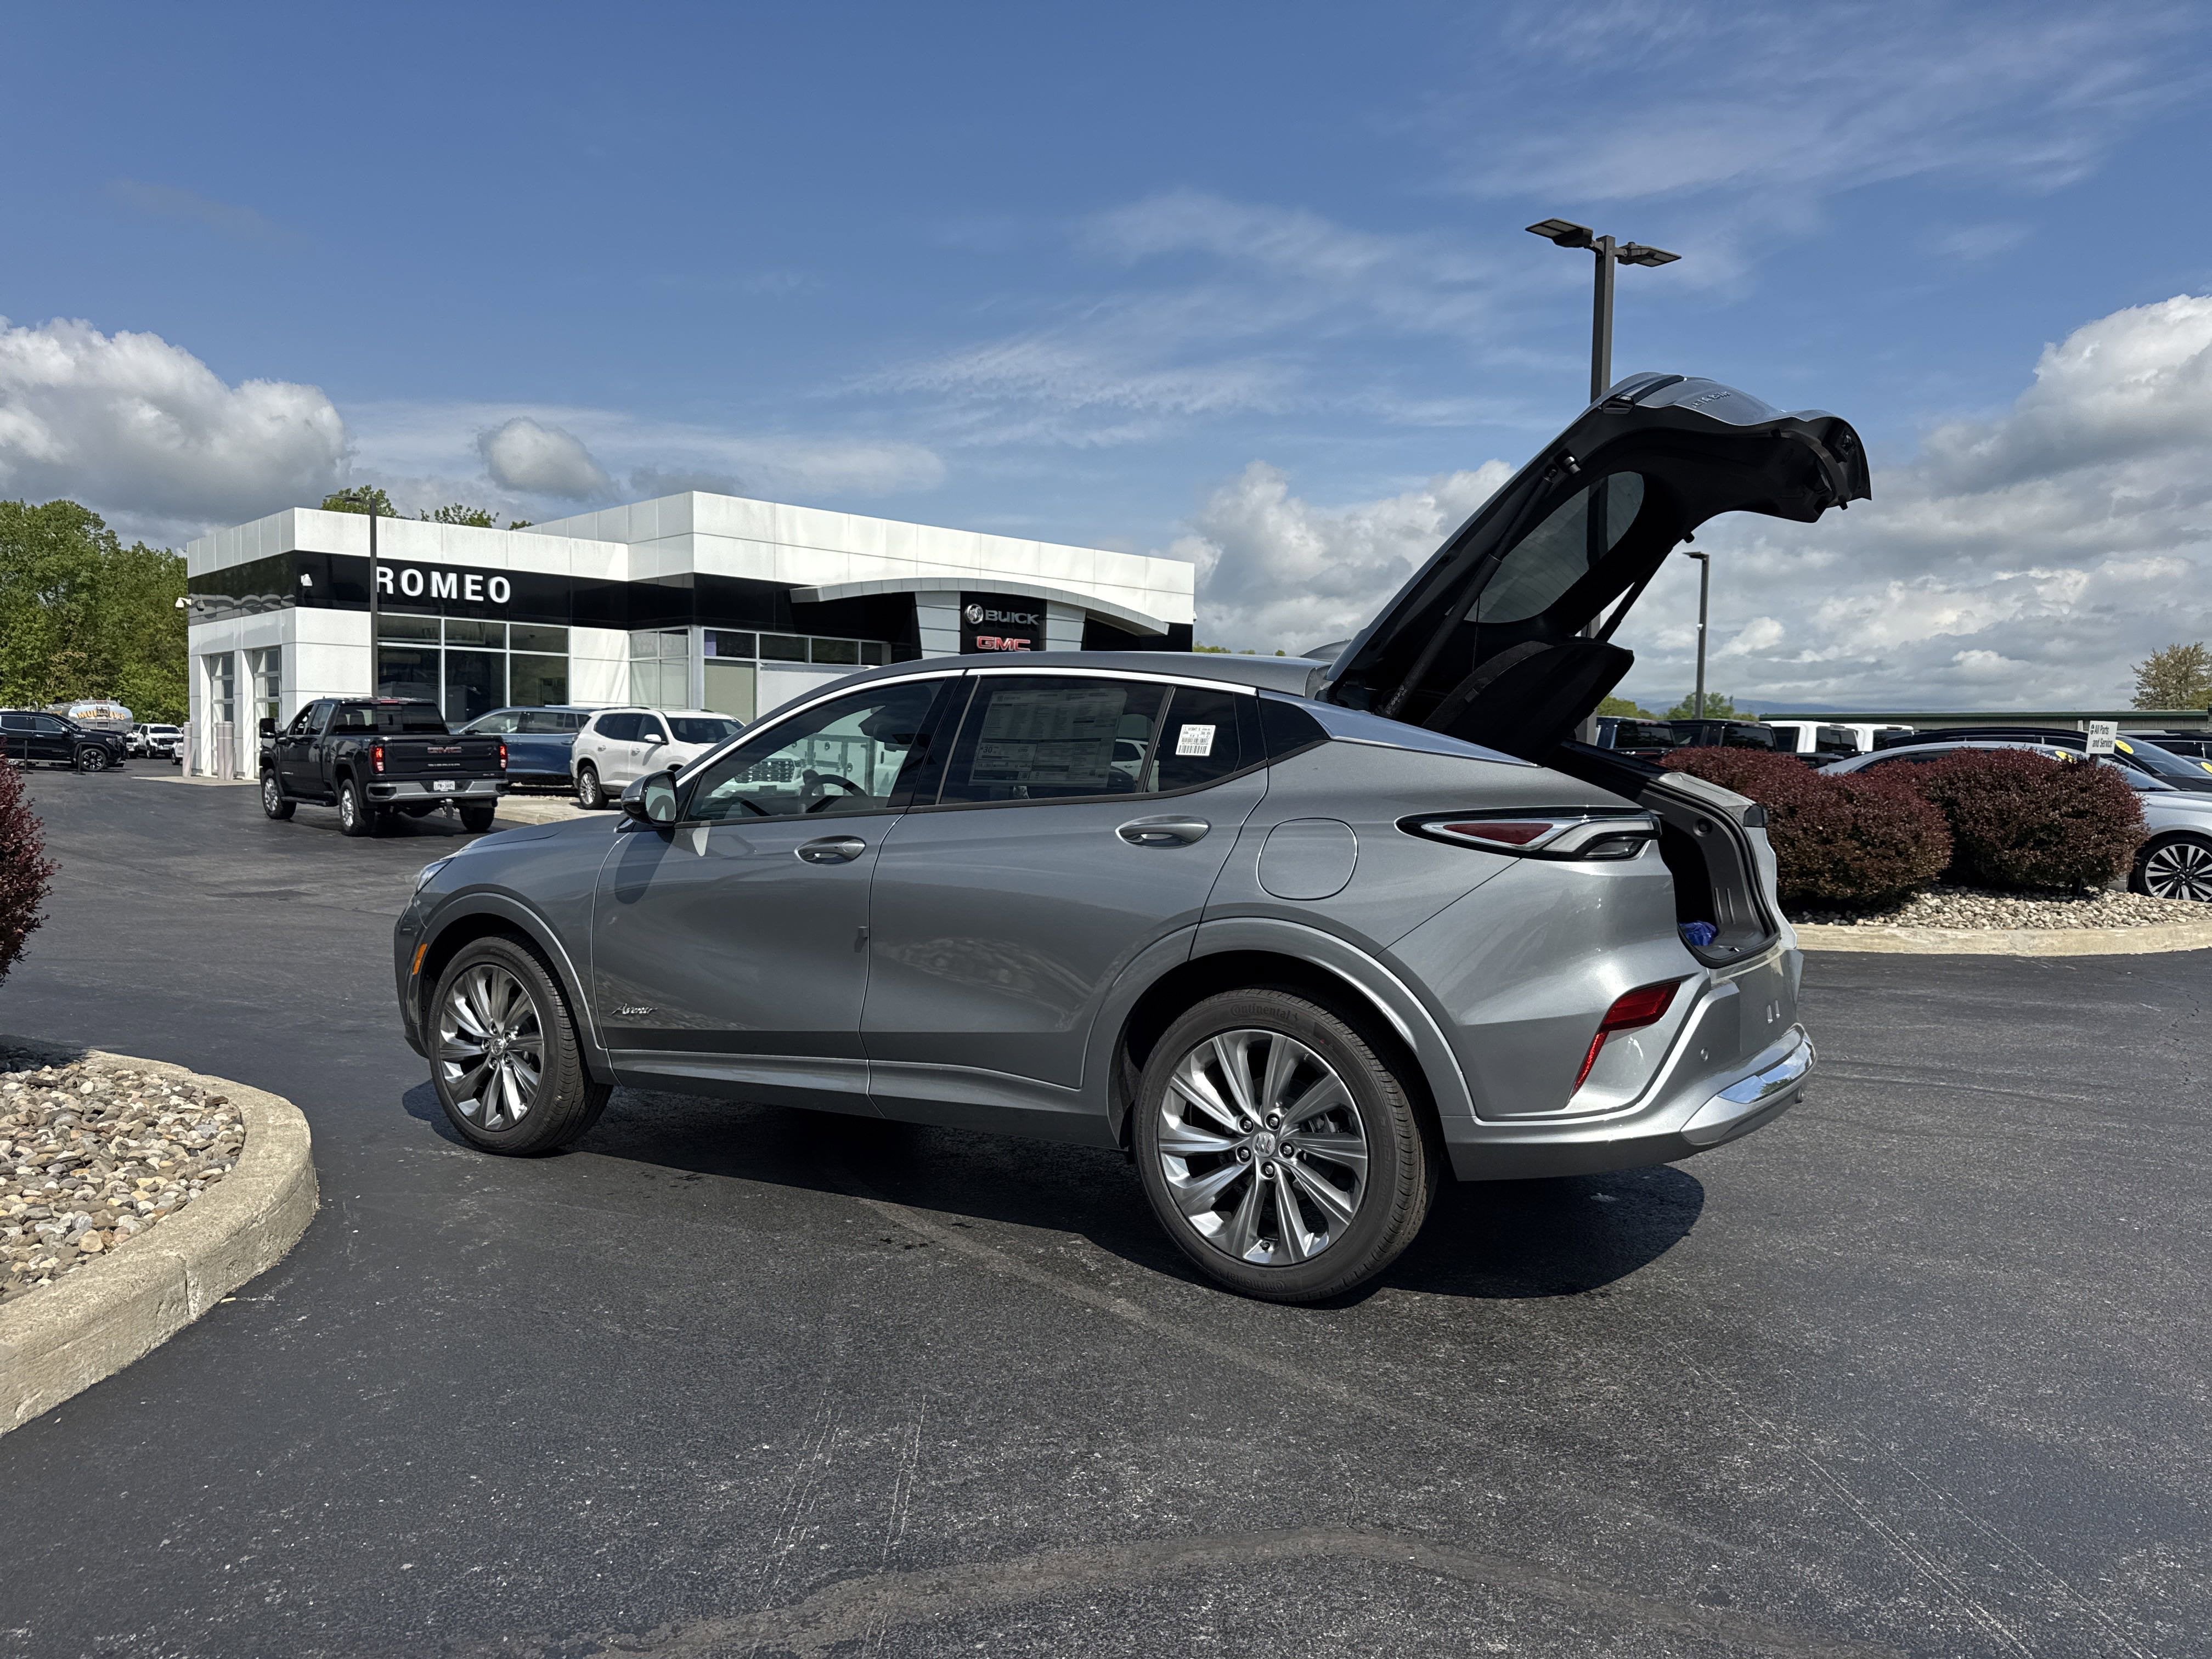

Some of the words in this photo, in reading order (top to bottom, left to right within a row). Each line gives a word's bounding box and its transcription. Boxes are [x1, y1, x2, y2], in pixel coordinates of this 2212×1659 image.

[376, 566, 511, 604] ROMEO
[985, 609, 1040, 625] BUICK
[977, 635, 1031, 652] GMC
[1231, 1003, 1291, 1019] Continental
